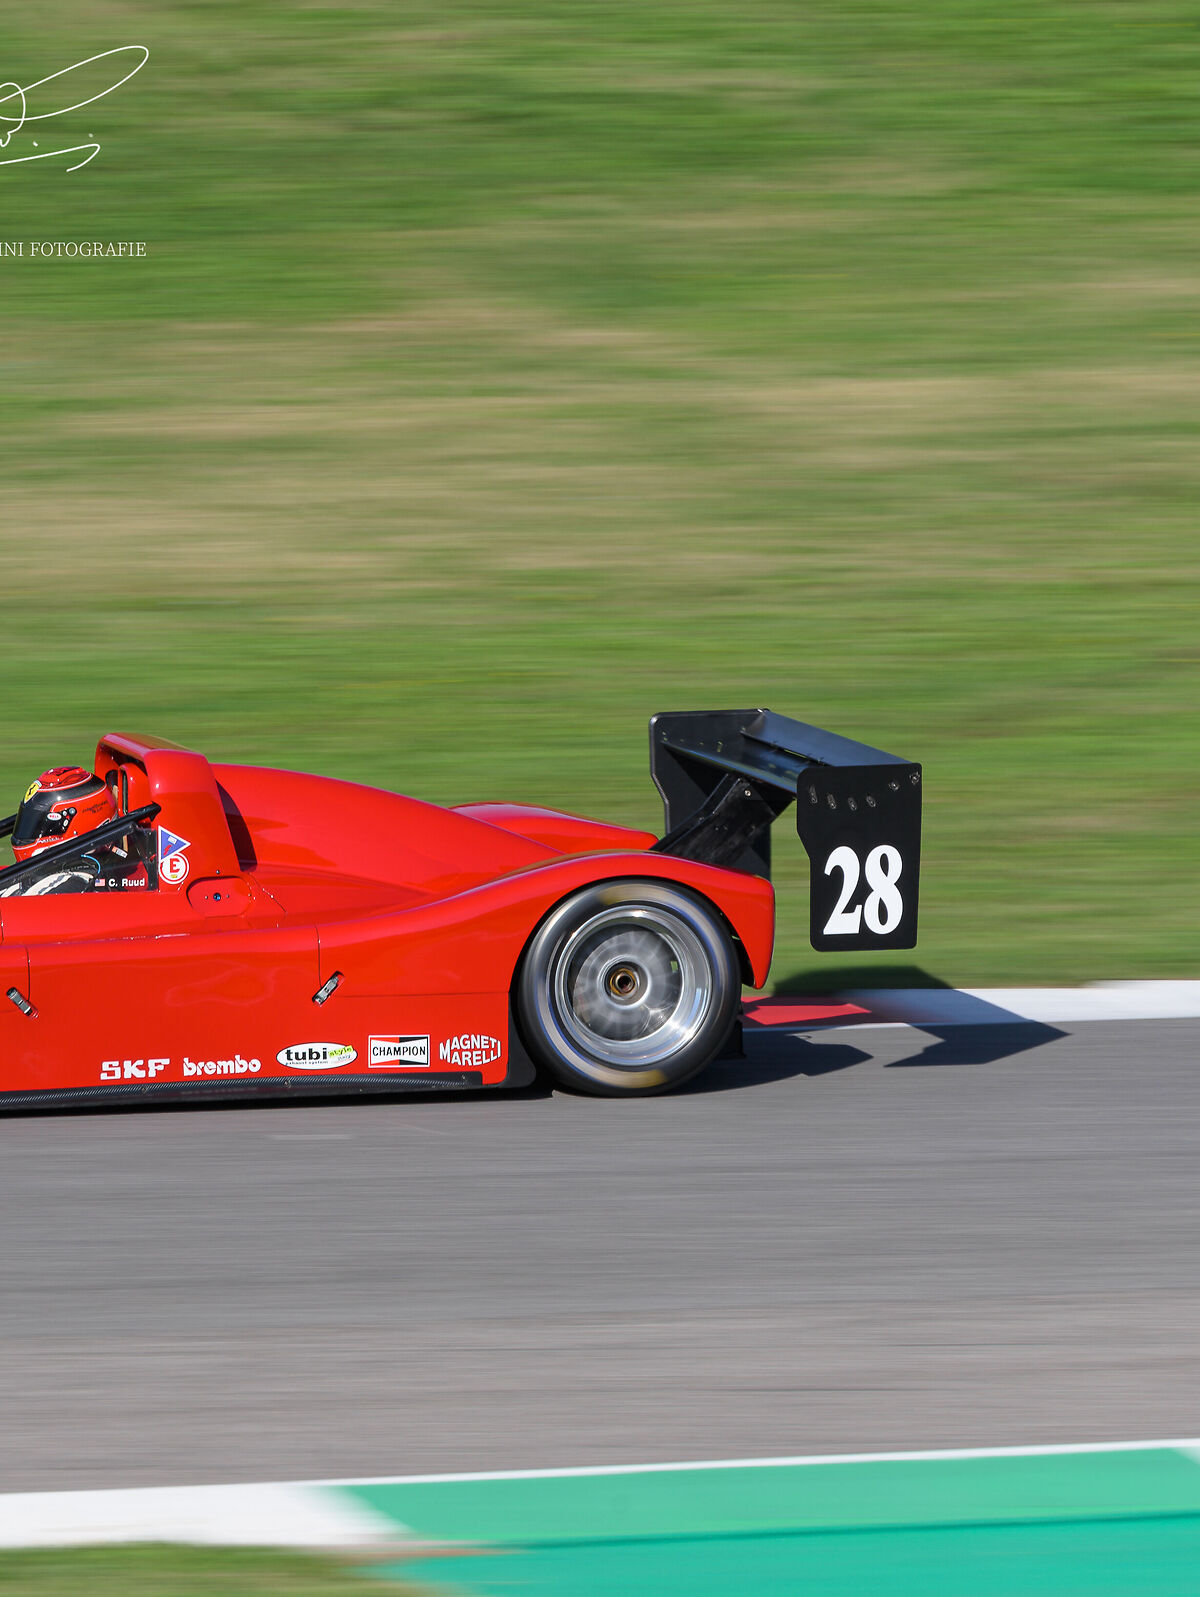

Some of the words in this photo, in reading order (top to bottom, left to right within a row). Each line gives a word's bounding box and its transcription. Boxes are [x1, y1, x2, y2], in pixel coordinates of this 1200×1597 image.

[169, 857, 181, 873] E
[108, 878, 118, 887] C.
[121, 877, 146, 887] Ruud
[822, 844, 903, 935] 28
[285, 1047, 328, 1061] tubi
[329, 1045, 353, 1057] style
[372, 1046, 426, 1057] CHAMPION
[440, 1034, 501, 1056] MAGNETI
[440, 1043, 501, 1066] MARELLI
[100, 1058, 171, 1080] SKF
[183, 1054, 262, 1077] brembo
